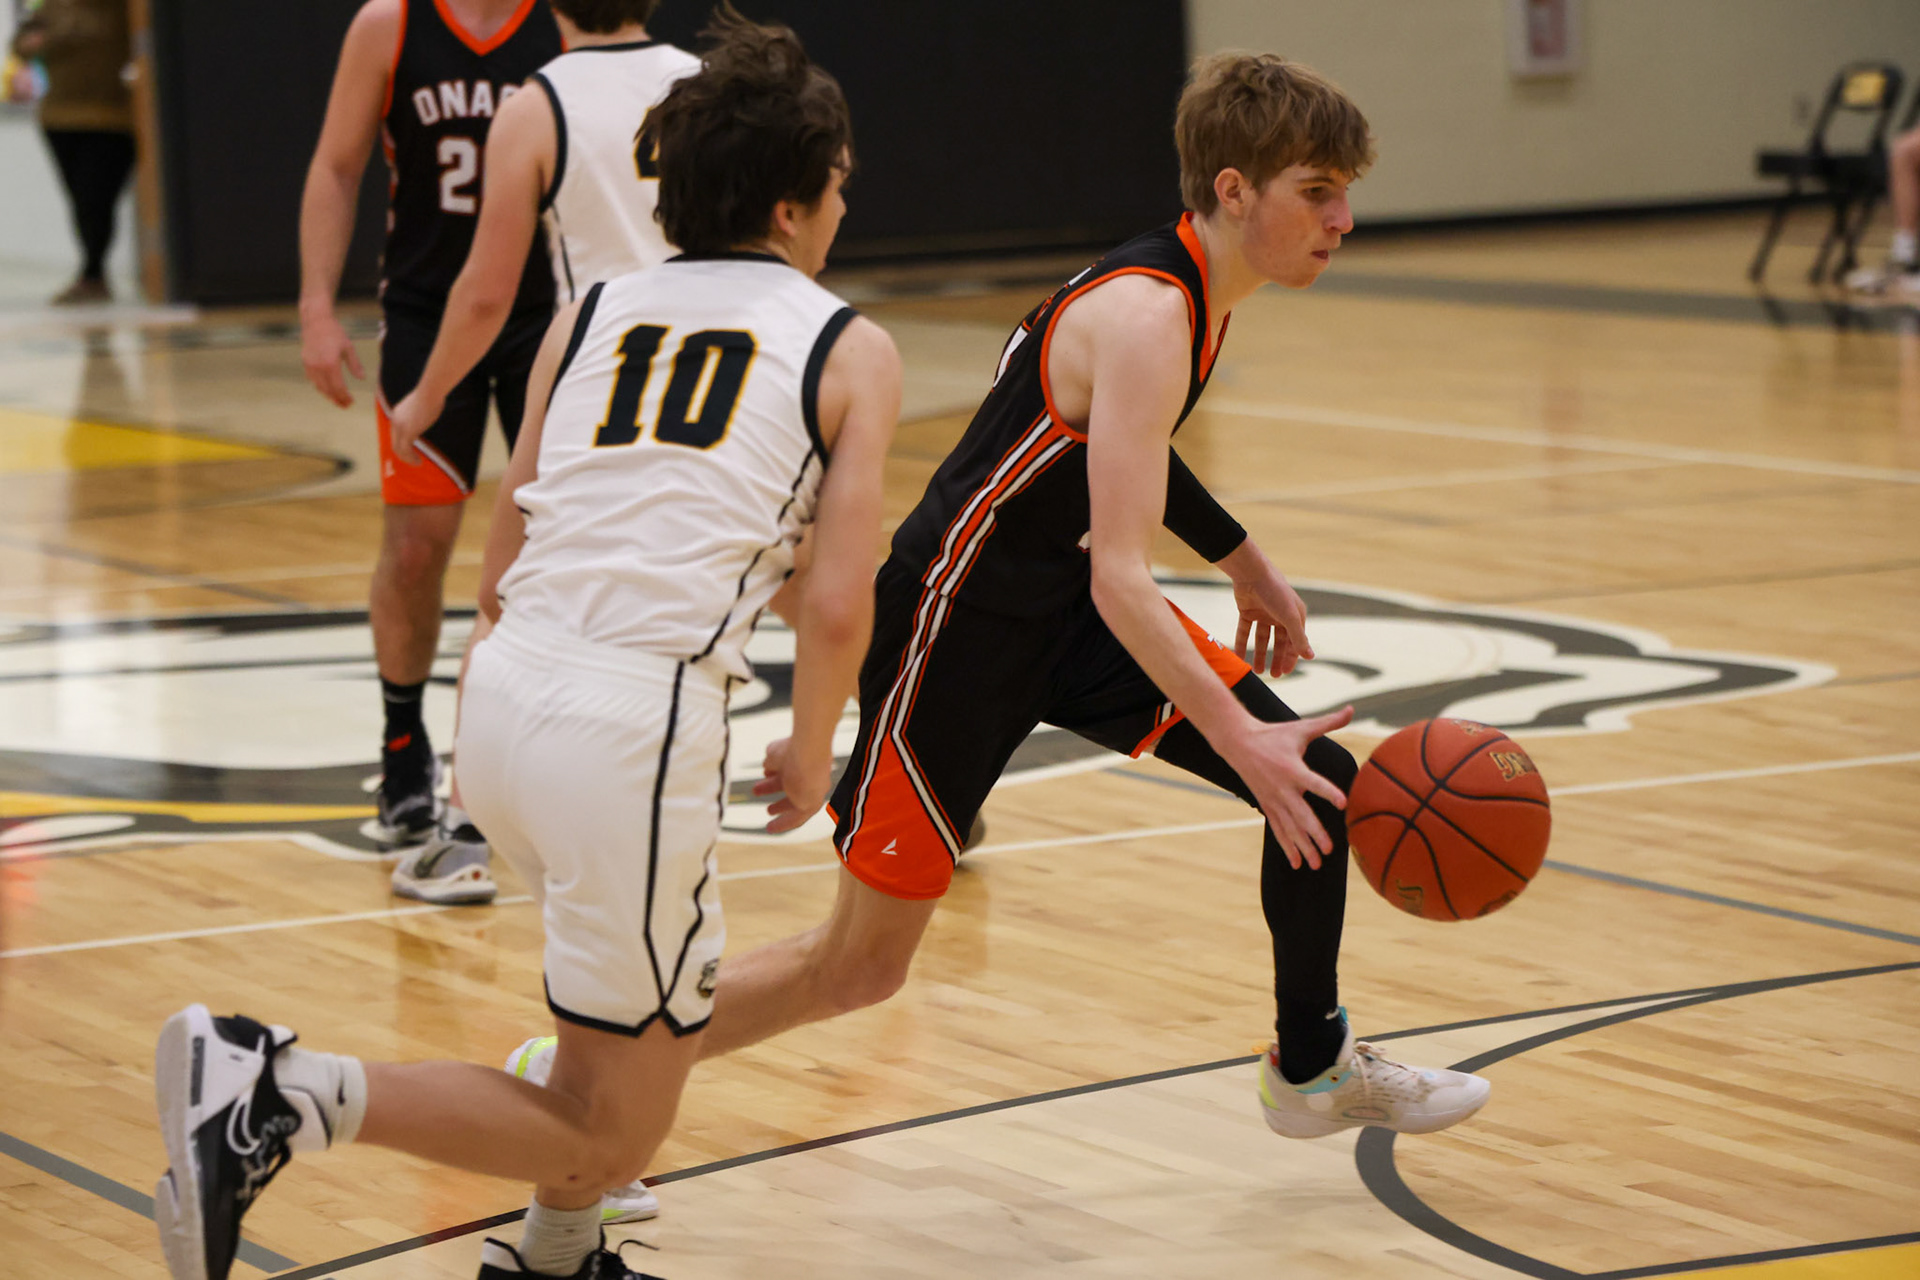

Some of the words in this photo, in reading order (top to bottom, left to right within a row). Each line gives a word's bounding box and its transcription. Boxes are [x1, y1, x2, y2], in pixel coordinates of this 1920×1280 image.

[411, 79, 521, 126] ONA
[437, 136, 486, 215] 2
[591, 323, 760, 451] 10
